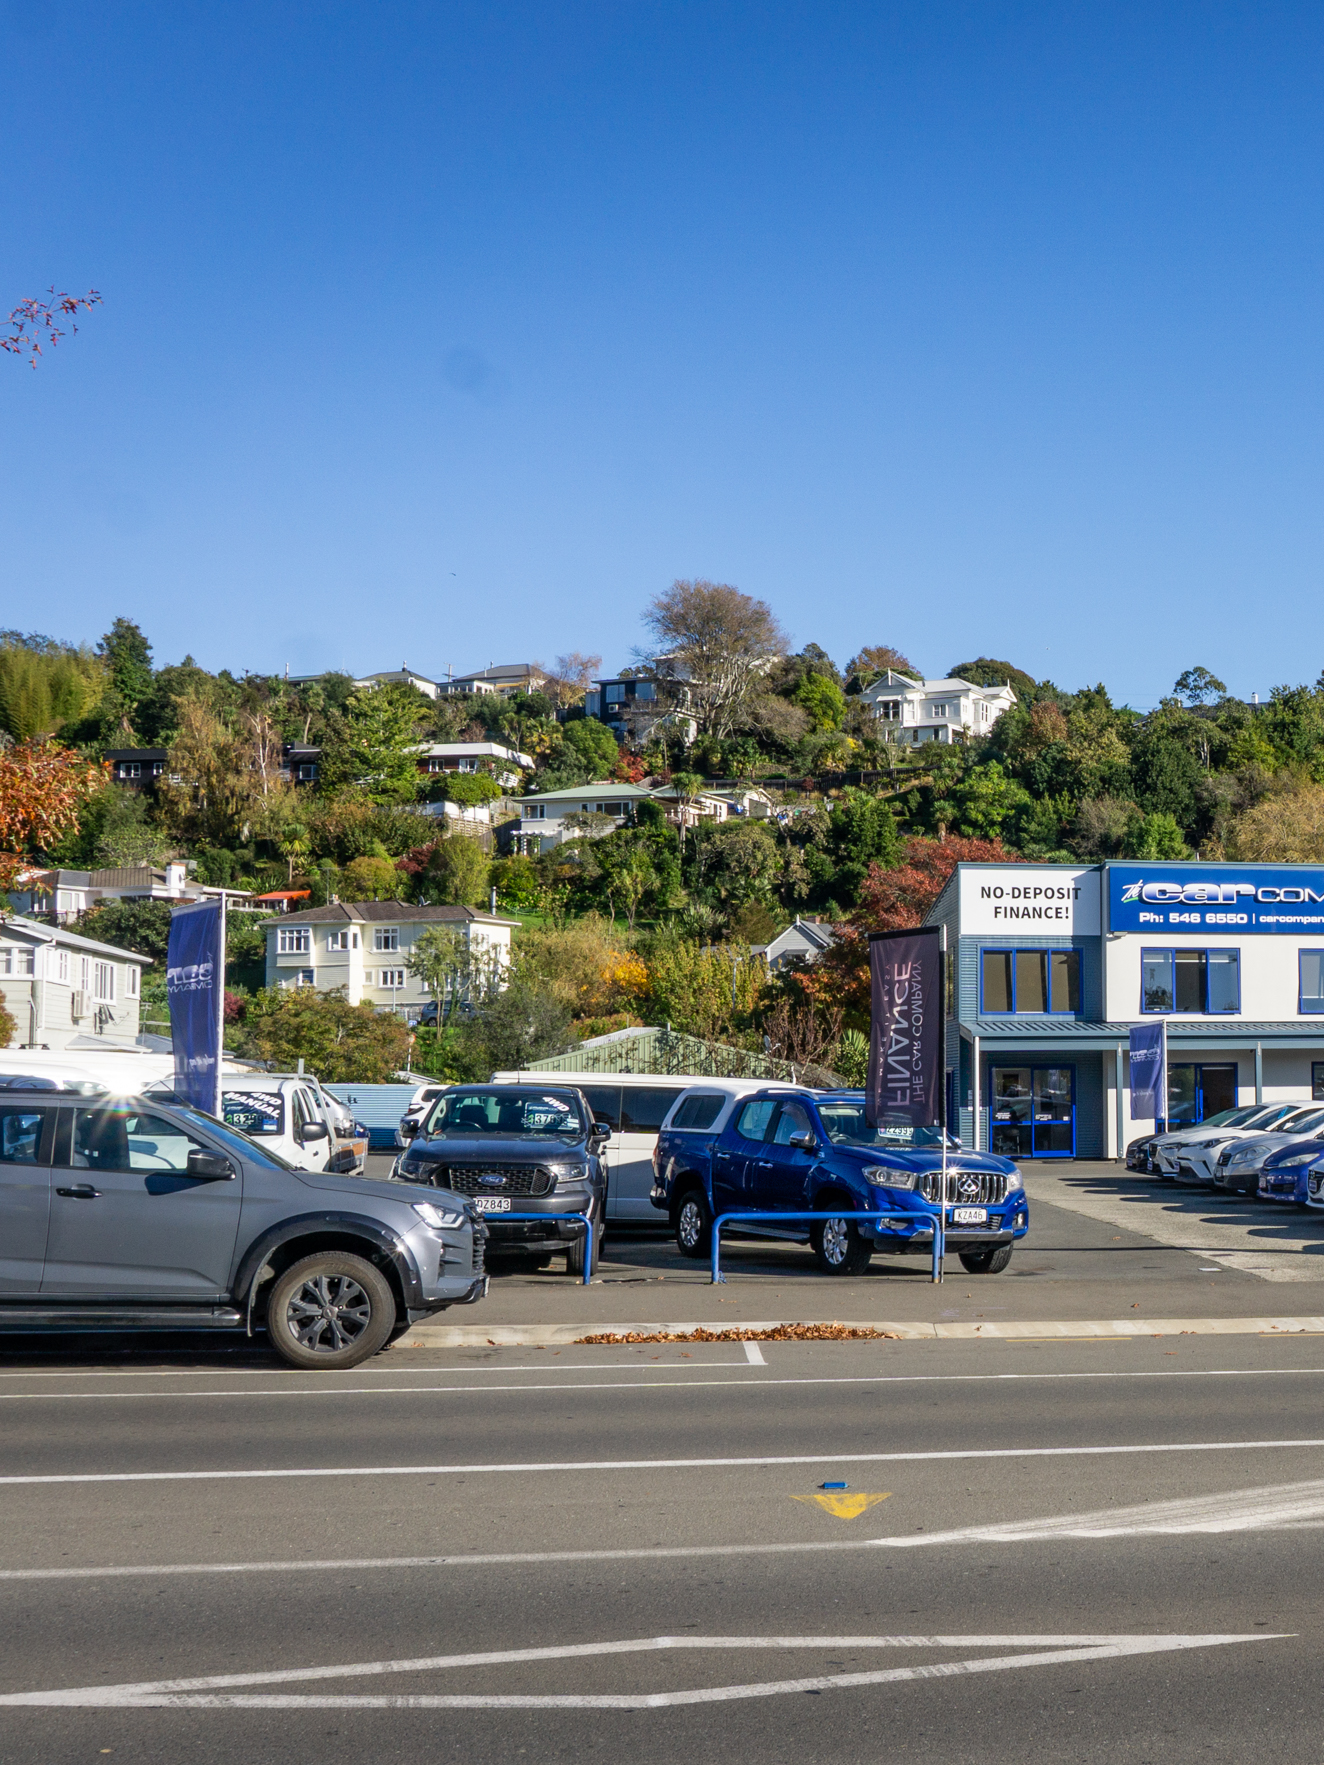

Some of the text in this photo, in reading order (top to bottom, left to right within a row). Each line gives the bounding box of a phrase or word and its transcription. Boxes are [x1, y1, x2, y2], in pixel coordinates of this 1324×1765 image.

[981, 886, 1081, 900] NO-DEPOSIT
[1142, 882, 1256, 904] car
[994, 905, 1069, 919] FINANCE!
[1139, 912, 1248, 924] Ph: 546 6550
[223, 1091, 281, 1118] MANUAL
[250, 1092, 282, 1105] 4WD
[957, 1210, 983, 1220] KZA46
